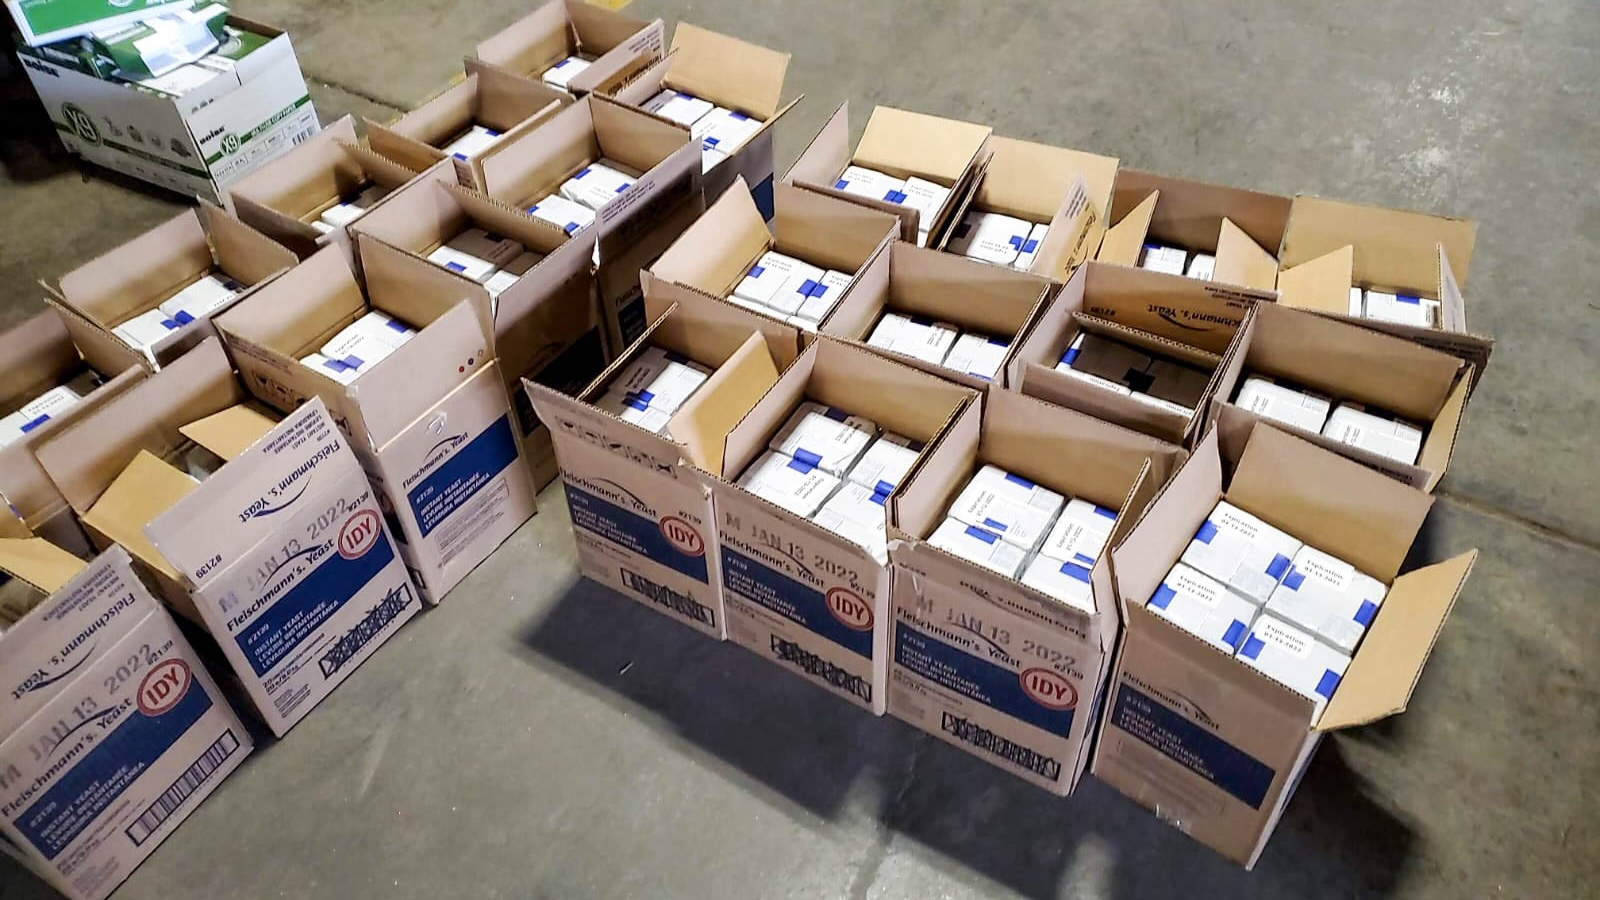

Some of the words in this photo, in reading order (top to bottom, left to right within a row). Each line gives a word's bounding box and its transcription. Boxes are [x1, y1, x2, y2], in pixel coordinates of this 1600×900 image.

[225, 134, 238, 154] X9
[1148, 304, 1177, 317] Yeast
[451, 432, 468, 449] Yeast
[239, 497, 270, 523] Yeast
[631, 500, 657, 517] Yeast
[248, 556, 279, 591] JAN
[281, 539, 302, 561] 13
[306, 497, 350, 541] 2022
[345, 517, 372, 549] IDY
[668, 524, 695, 546] IDY
[305, 539, 335, 565] Yeast
[725, 512, 741, 531] M
[752, 525, 781, 551] JAN
[787, 542, 805, 560] 13
[814, 555, 858, 583] 2022
[195, 554, 222, 579] #2139
[794, 568, 824, 587] Yeast
[836, 595, 864, 621] IDY
[281, 612, 305, 630] YEAST
[247, 623, 270, 645] #2139
[944, 608, 983, 635] JAN
[990, 627, 1010, 645] 13
[1022, 639, 1076, 667] 2022
[988, 648, 1021, 669] Yeast
[10, 669, 49, 699] Yeast
[146, 668, 180, 705] IDY
[1032, 676, 1068, 700] IDY
[28, 719, 70, 761] JAN
[72, 696, 98, 721] 13
[104, 643, 151, 695] 2022
[96, 697, 133, 730] Yeast
